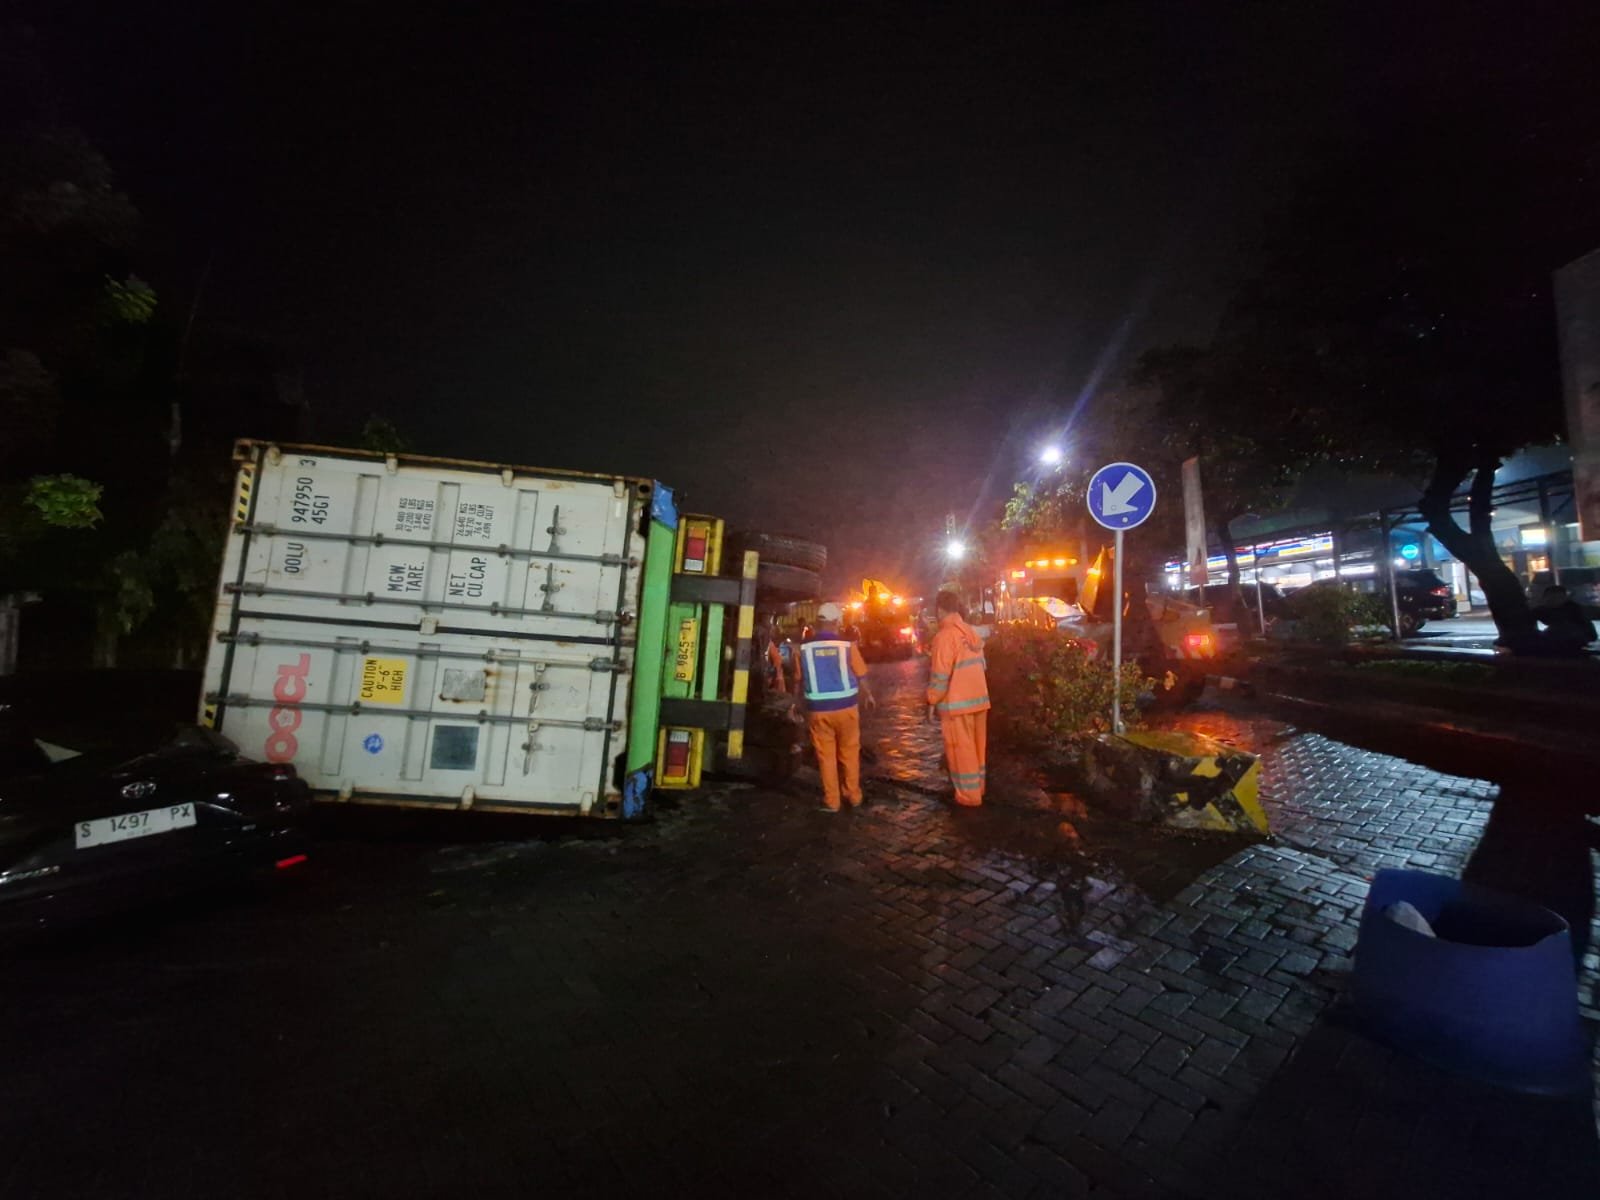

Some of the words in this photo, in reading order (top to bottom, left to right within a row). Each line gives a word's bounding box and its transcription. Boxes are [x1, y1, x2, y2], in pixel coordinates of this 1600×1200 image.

[300, 459, 317, 467] 3
[291, 477, 314, 523] 947950
[311, 495, 330, 525] 45G1
[387, 563, 407, 592] MGW.
[405, 561, 425, 592] TARE.
[448, 572, 467, 597] NET.
[361, 659, 377, 698] CAUTION
[391, 670, 404, 691] HIGH
[264, 653, 311, 764] OOCL
[81, 823, 91, 838] S
[109, 813, 149, 832] 1497
[170, 805, 191, 820] PX
